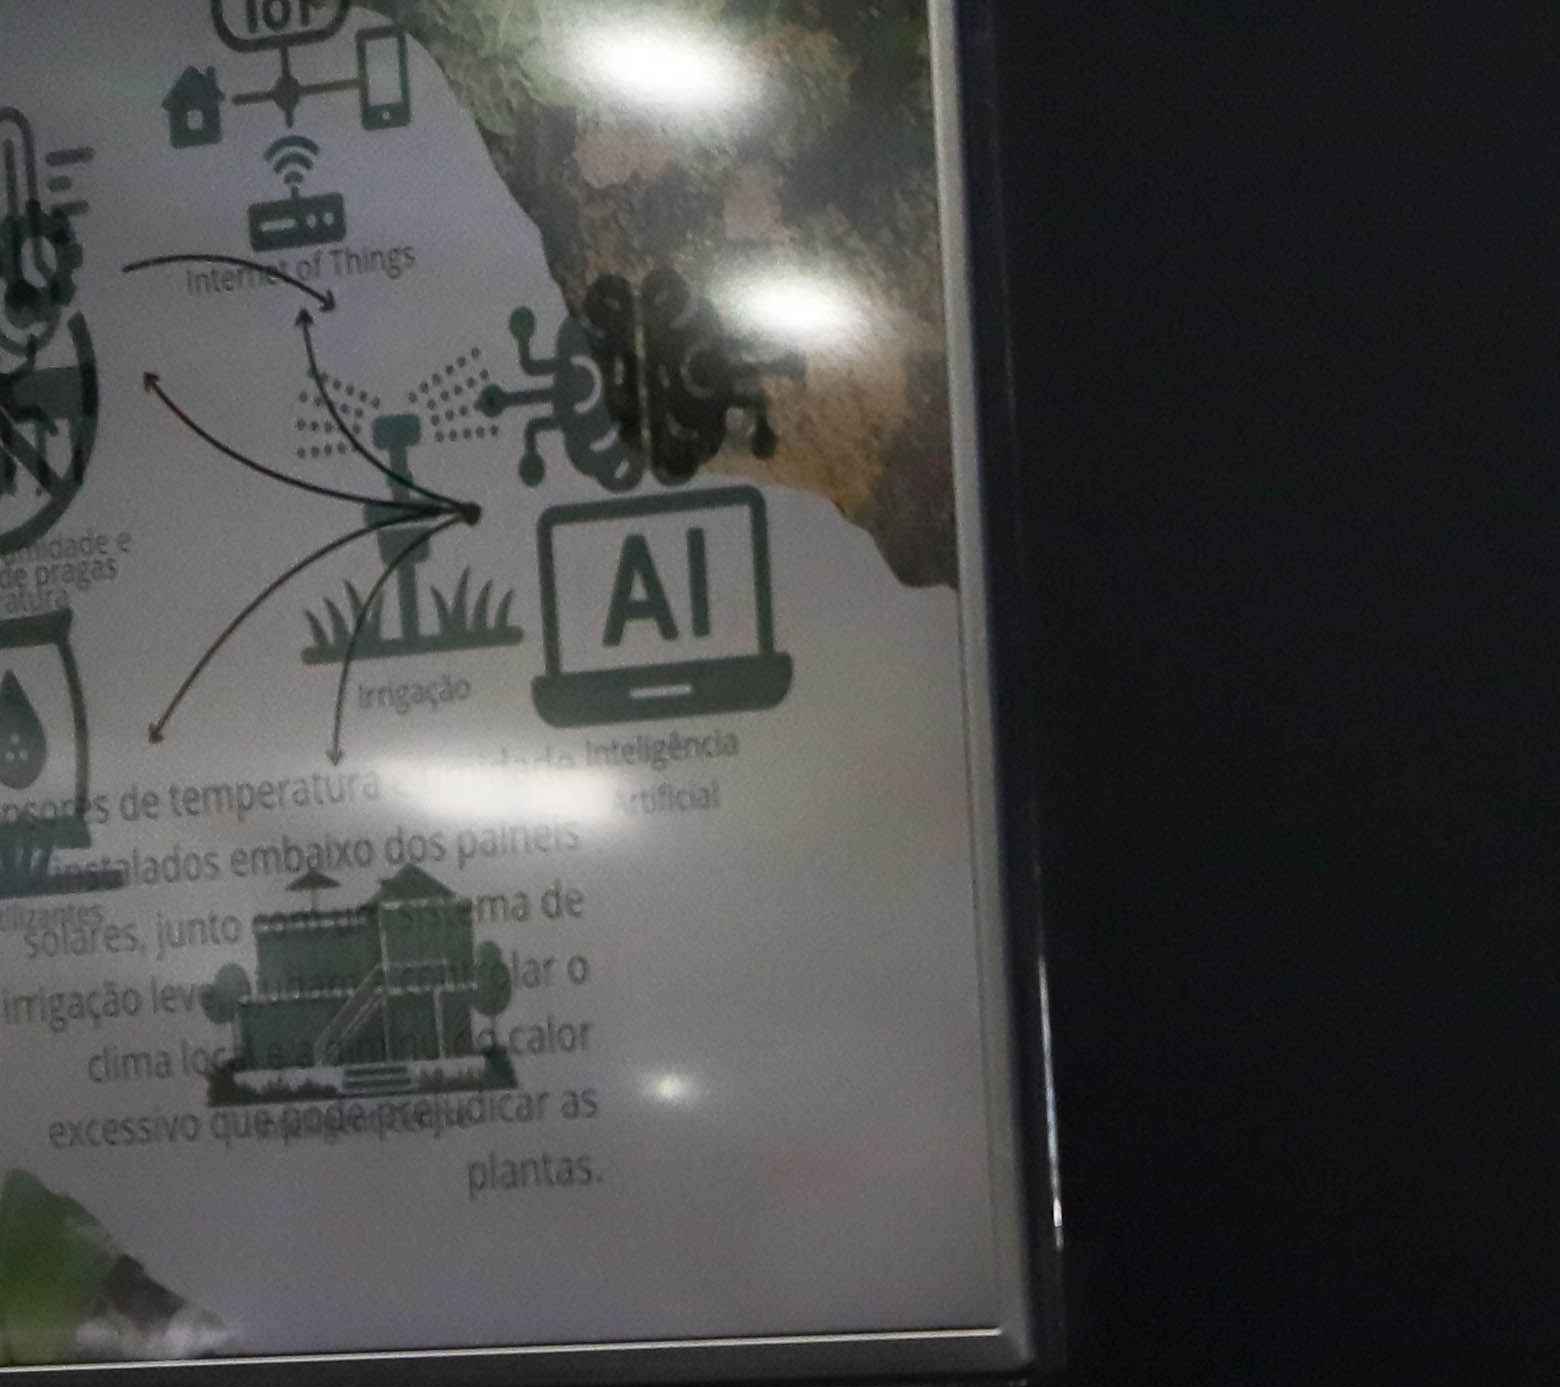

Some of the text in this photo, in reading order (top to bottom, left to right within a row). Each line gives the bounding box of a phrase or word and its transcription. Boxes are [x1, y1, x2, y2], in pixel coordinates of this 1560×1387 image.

[186, 245, 416, 295] Internet of Things
[36, 557, 118, 590] pragas
[602, 526, 710, 647] AI
[357, 675, 471, 715] Irrigação
[585, 729, 740, 771] Inteligência
[119, 783, 160, 821] de
[169, 768, 380, 822] temperatura
[229, 833, 374, 877] embaixo
[384, 826, 446, 865] dos
[156, 911, 243, 961] junto
[541, 879, 586, 921] de
[88, 1045, 173, 1084] clima
[509, 1014, 593, 1054] calor
[49, 1107, 200, 1148] excessivo
[560, 1087, 598, 1120] as
[467, 1152, 603, 1199] plantas.
